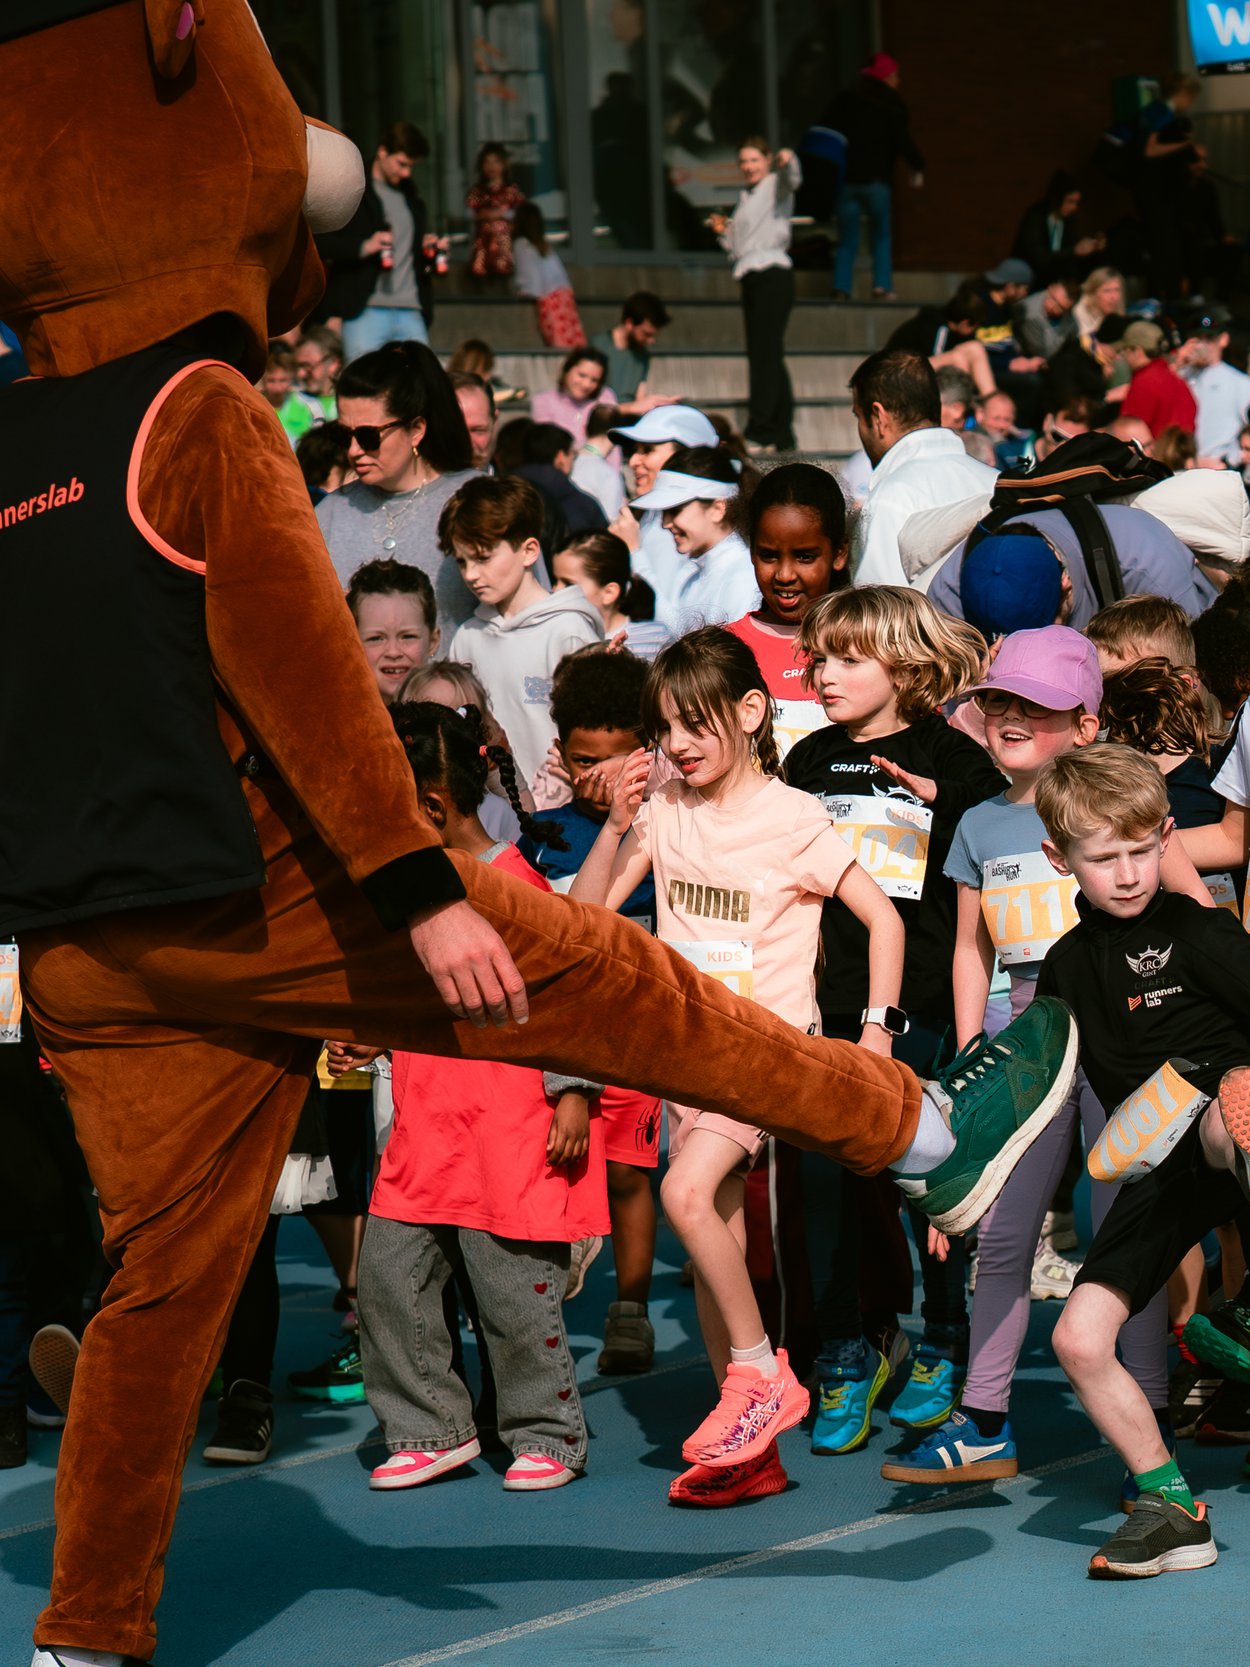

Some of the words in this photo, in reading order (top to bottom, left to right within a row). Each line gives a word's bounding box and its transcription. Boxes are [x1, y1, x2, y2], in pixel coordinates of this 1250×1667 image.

[782, 668, 807, 679] CRA
[830, 763, 870, 774] CRAFT
[890, 808, 925, 825] KIDS
[840, 827, 923, 876] 104
[1207, 884, 1227, 896] DS
[670, 879, 750, 923] PUMA
[987, 884, 1081, 940] 711
[706, 950, 743, 963] KIDS
[1139, 958, 1162, 973] KRC
[1144, 985, 1183, 1000] runners
[1145, 998, 1162, 1008] lab
